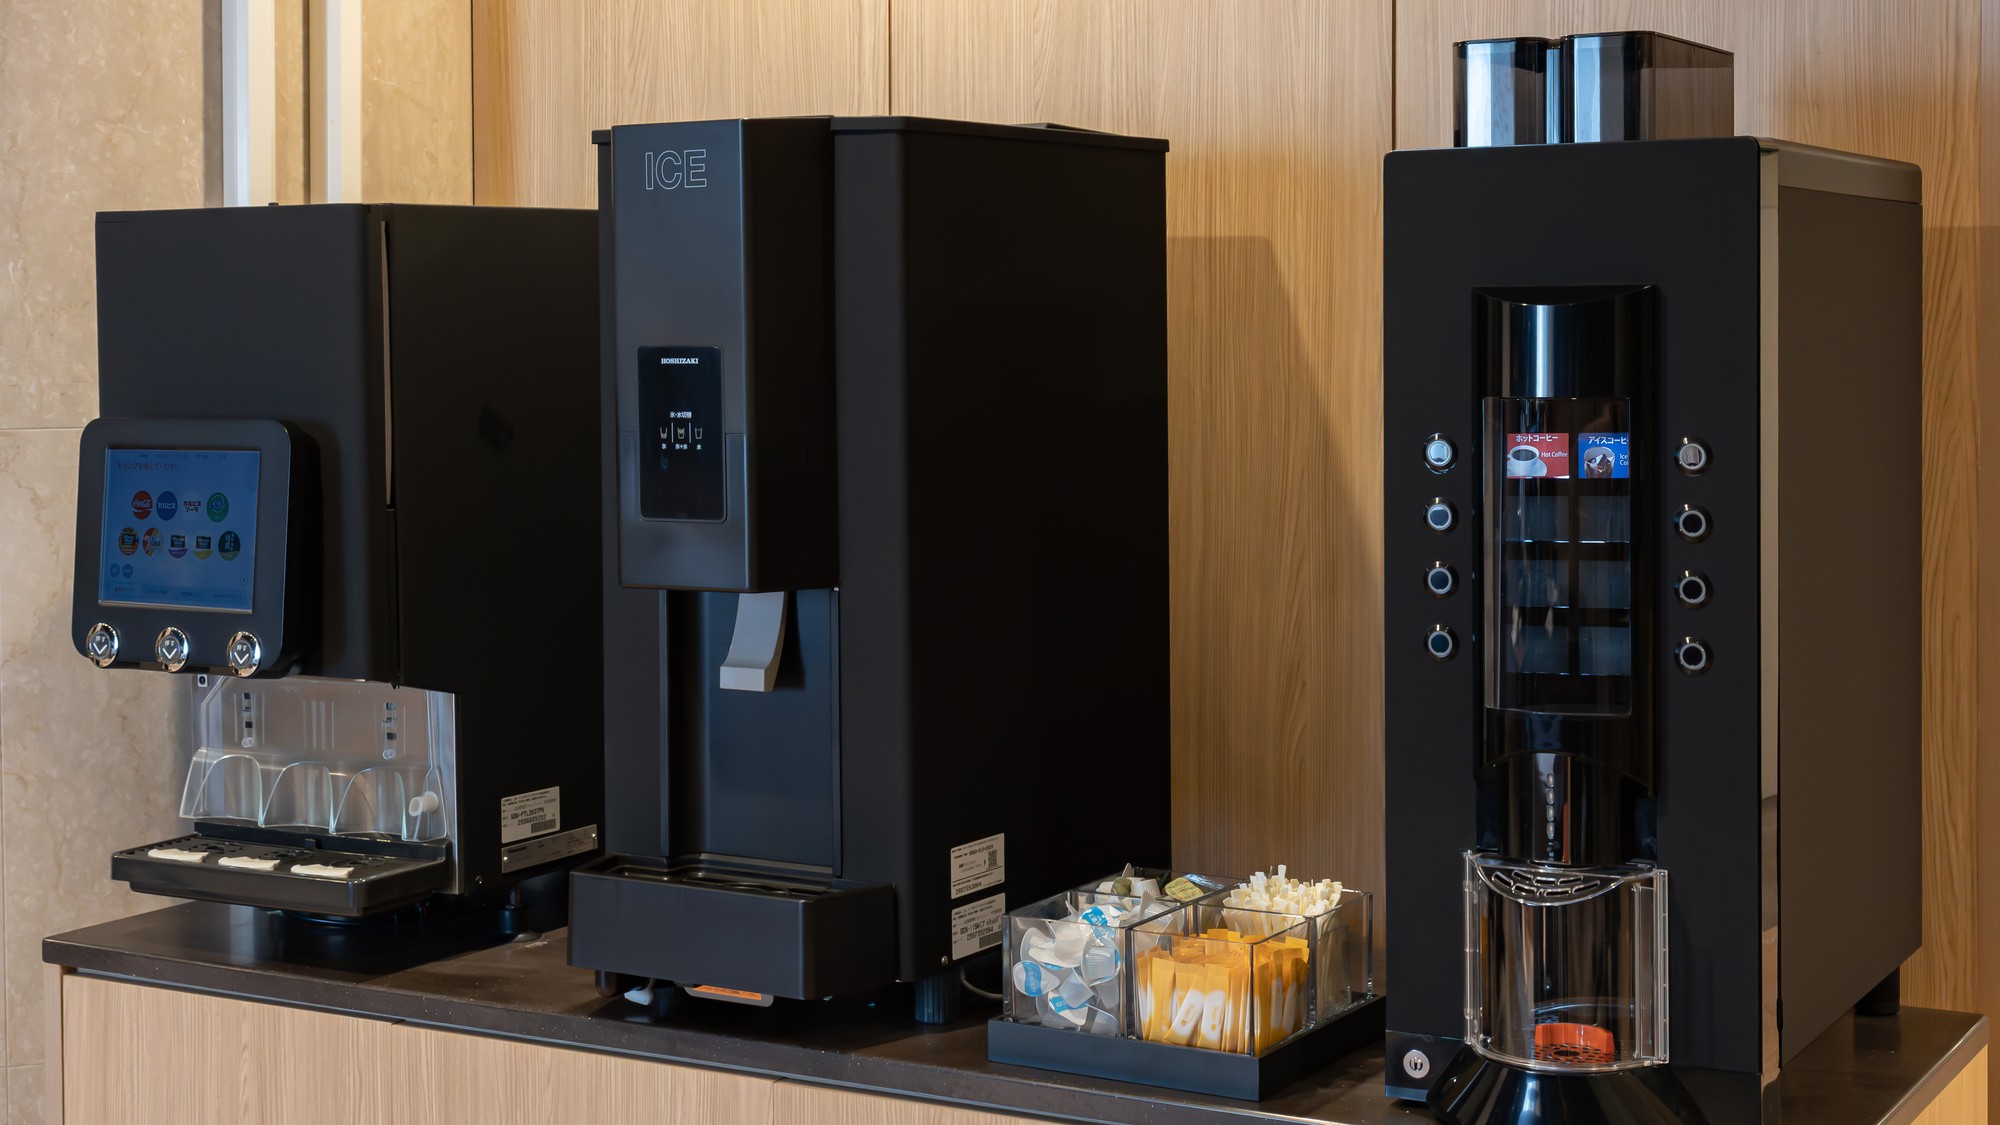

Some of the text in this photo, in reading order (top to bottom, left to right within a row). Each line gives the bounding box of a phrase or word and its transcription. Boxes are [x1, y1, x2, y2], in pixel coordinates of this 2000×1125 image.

[645, 148, 707, 190] ICE
[1515, 434, 1559, 443] ホットコーヒー
[1588, 436, 1629, 445] アイスコーヒ
